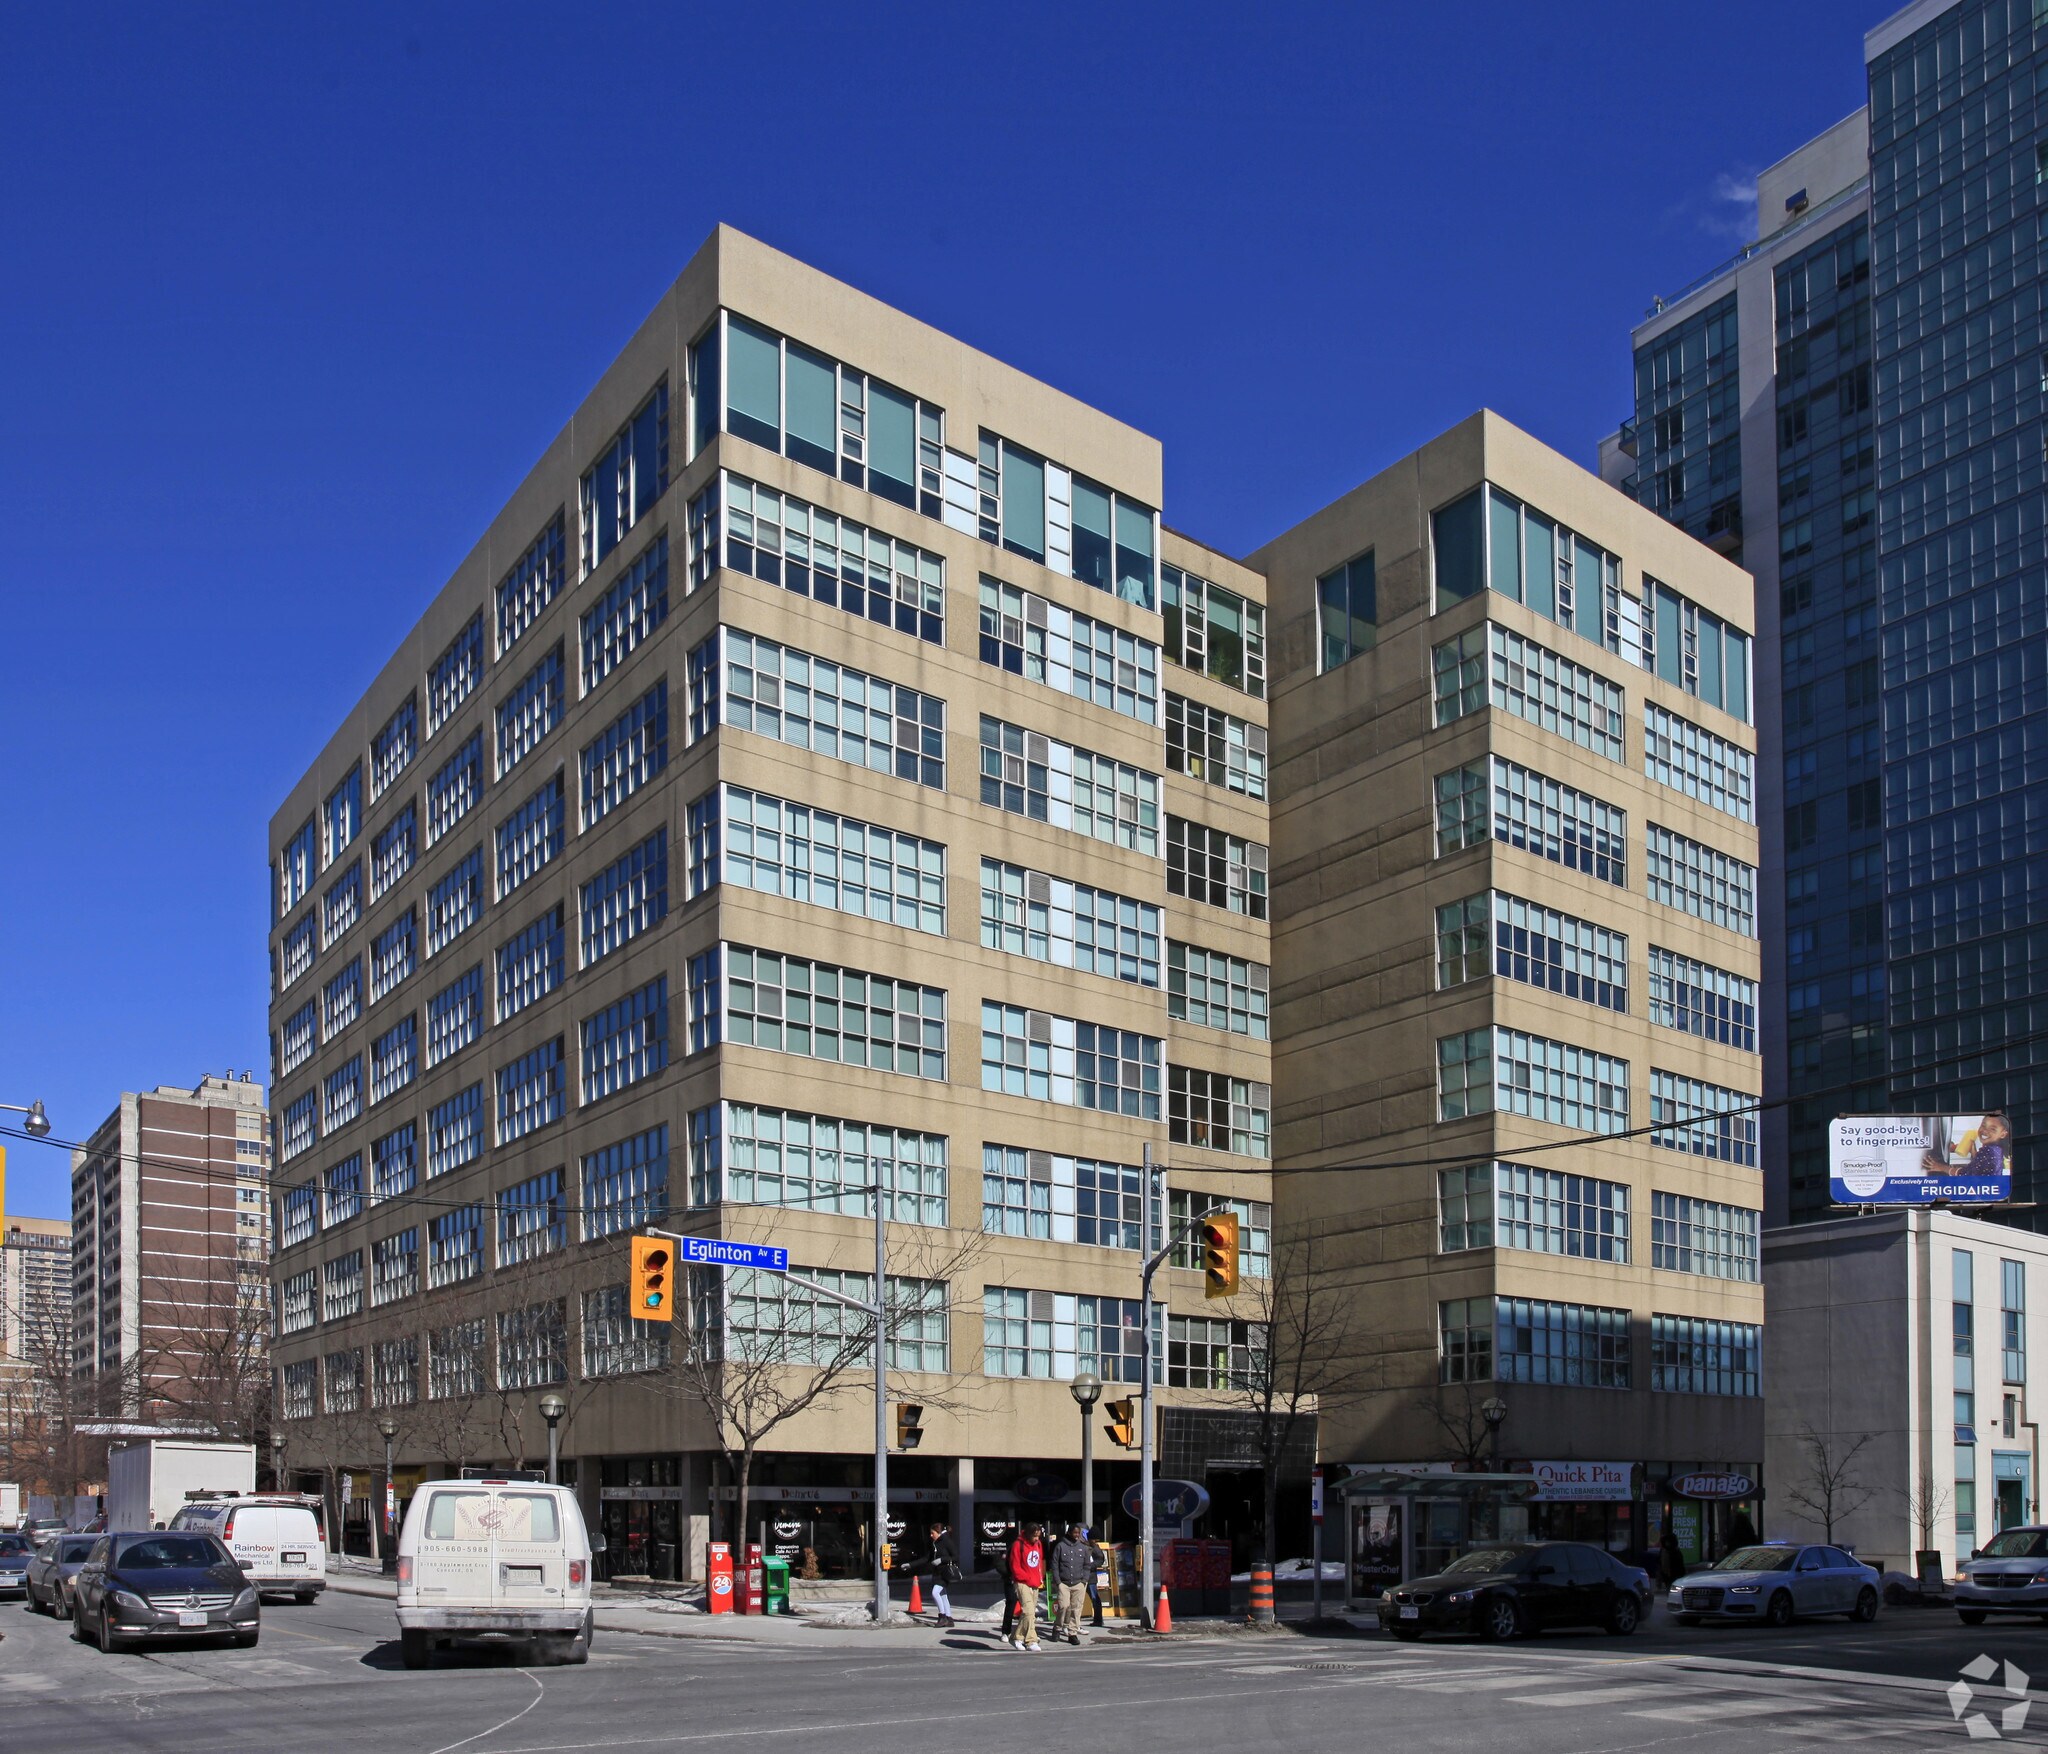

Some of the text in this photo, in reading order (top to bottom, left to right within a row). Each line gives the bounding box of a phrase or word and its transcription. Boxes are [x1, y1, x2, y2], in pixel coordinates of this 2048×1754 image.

[1840, 1125, 1920, 1136] Say good-bye
[1840, 1136, 1930, 1147] to fingerprints!
[1921, 1185, 2000, 1196] FRIGIDAIRE
[689, 1240, 782, 1265] Eglinton Av E
[1538, 1465, 1622, 1487] Quick Pita
[1682, 1475, 1749, 1495] panago
[1672, 1506, 1688, 1516] GET
[1672, 1517, 1697, 1527] FRESH
[234, 1544, 275, 1552] Rainbow
[1356, 1564, 1400, 1575] MasterChef
